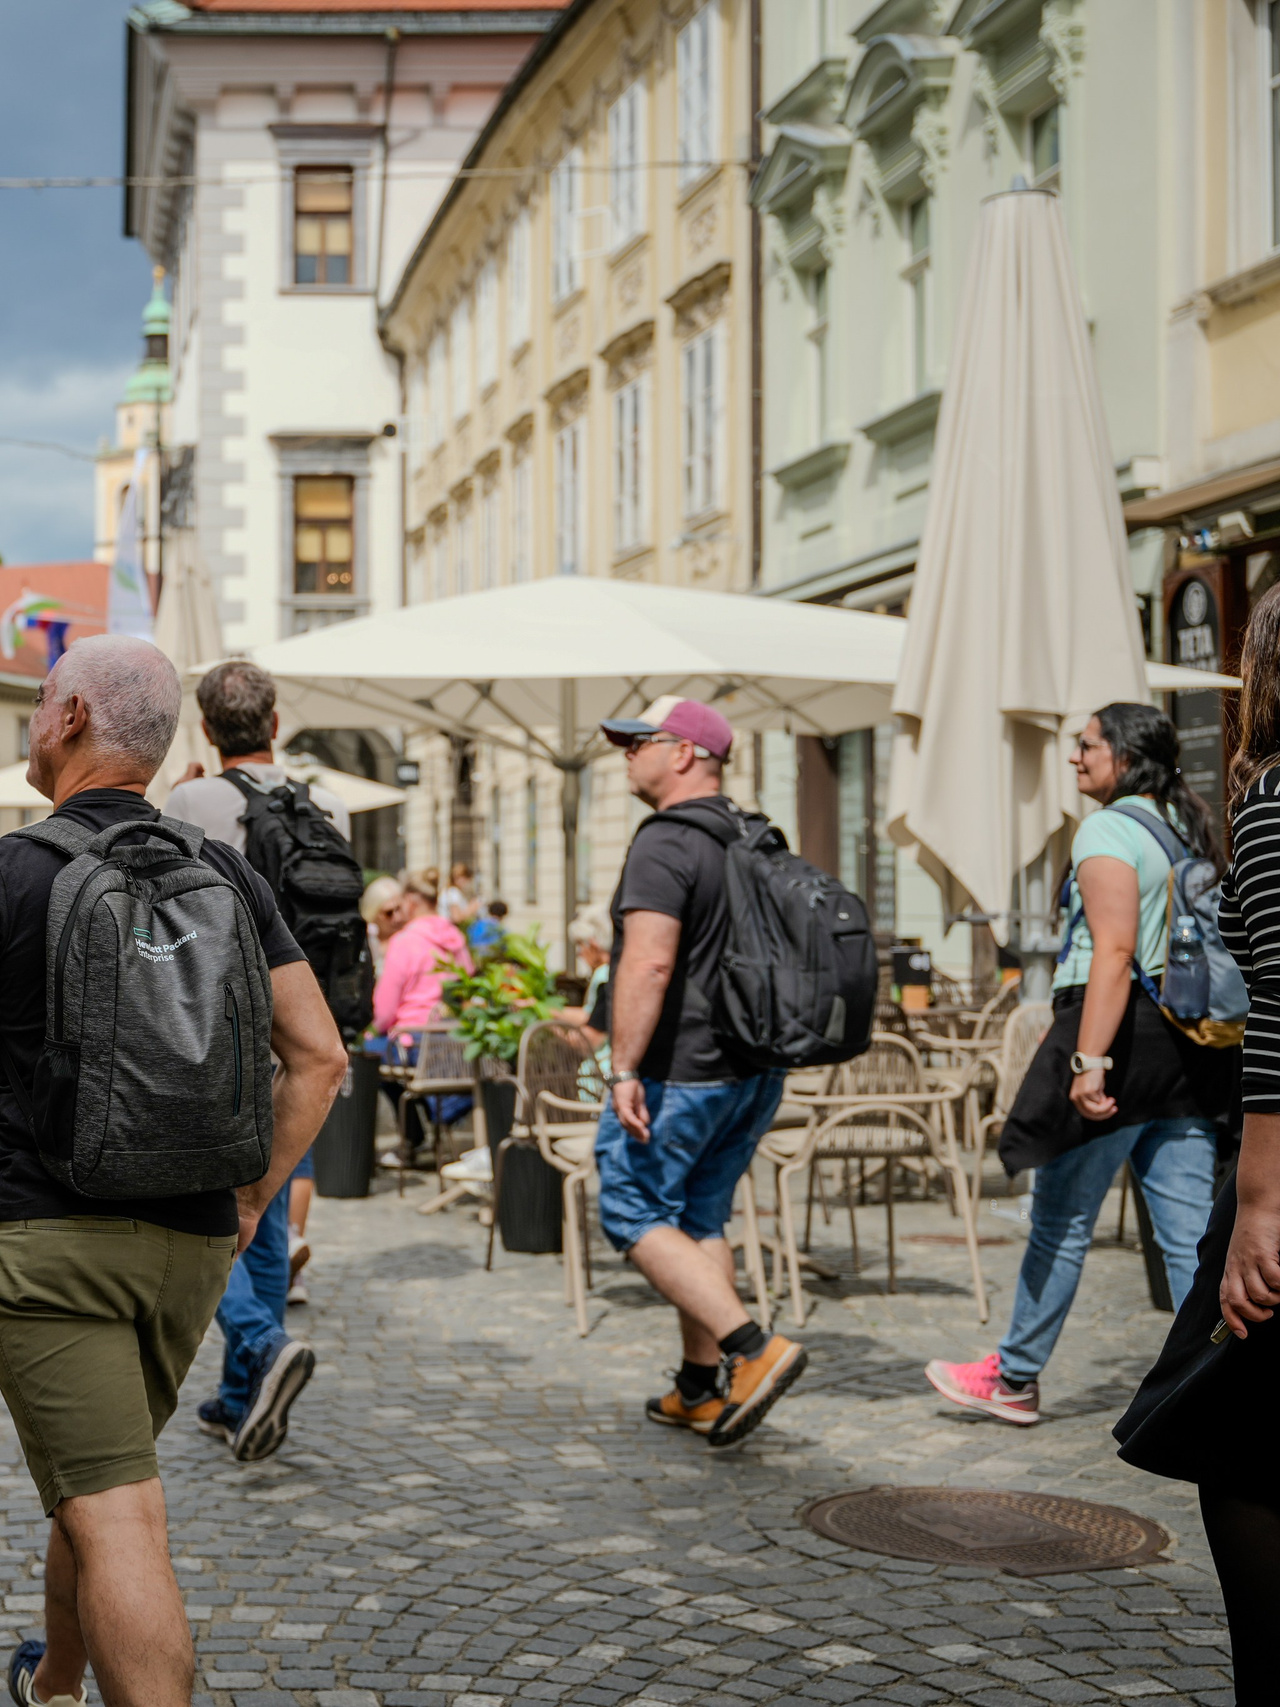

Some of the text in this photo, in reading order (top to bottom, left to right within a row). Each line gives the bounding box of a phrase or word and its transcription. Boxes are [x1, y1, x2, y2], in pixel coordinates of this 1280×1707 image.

[1177, 624, 1215, 661] TETA
[135, 930, 198, 953] Hewlett Packard
[137, 947, 175, 963] Enterprise
